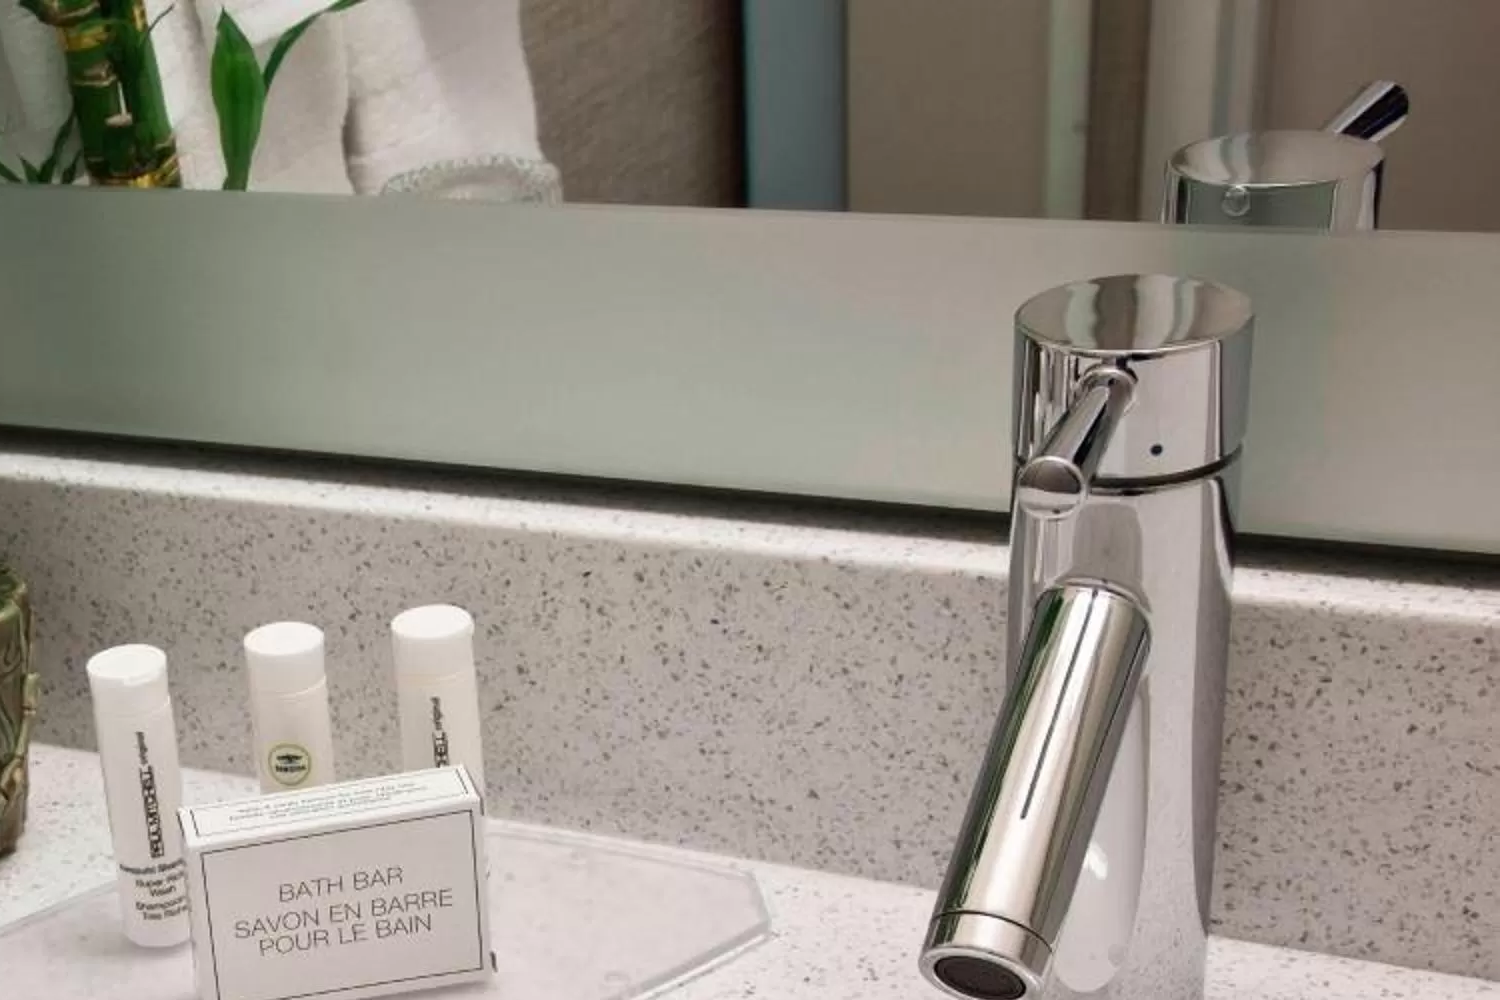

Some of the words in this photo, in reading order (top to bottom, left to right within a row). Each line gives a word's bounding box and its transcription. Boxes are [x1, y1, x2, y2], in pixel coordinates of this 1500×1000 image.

[278, 875, 344, 903] BATH
[352, 867, 404, 891] BAR
[234, 909, 320, 939] SAVON
[328, 904, 362, 925] EN
[371, 888, 453, 918] BARRE
[259, 929, 330, 957] POUR
[338, 923, 367, 945] LE
[376, 914, 432, 939] BAIN
